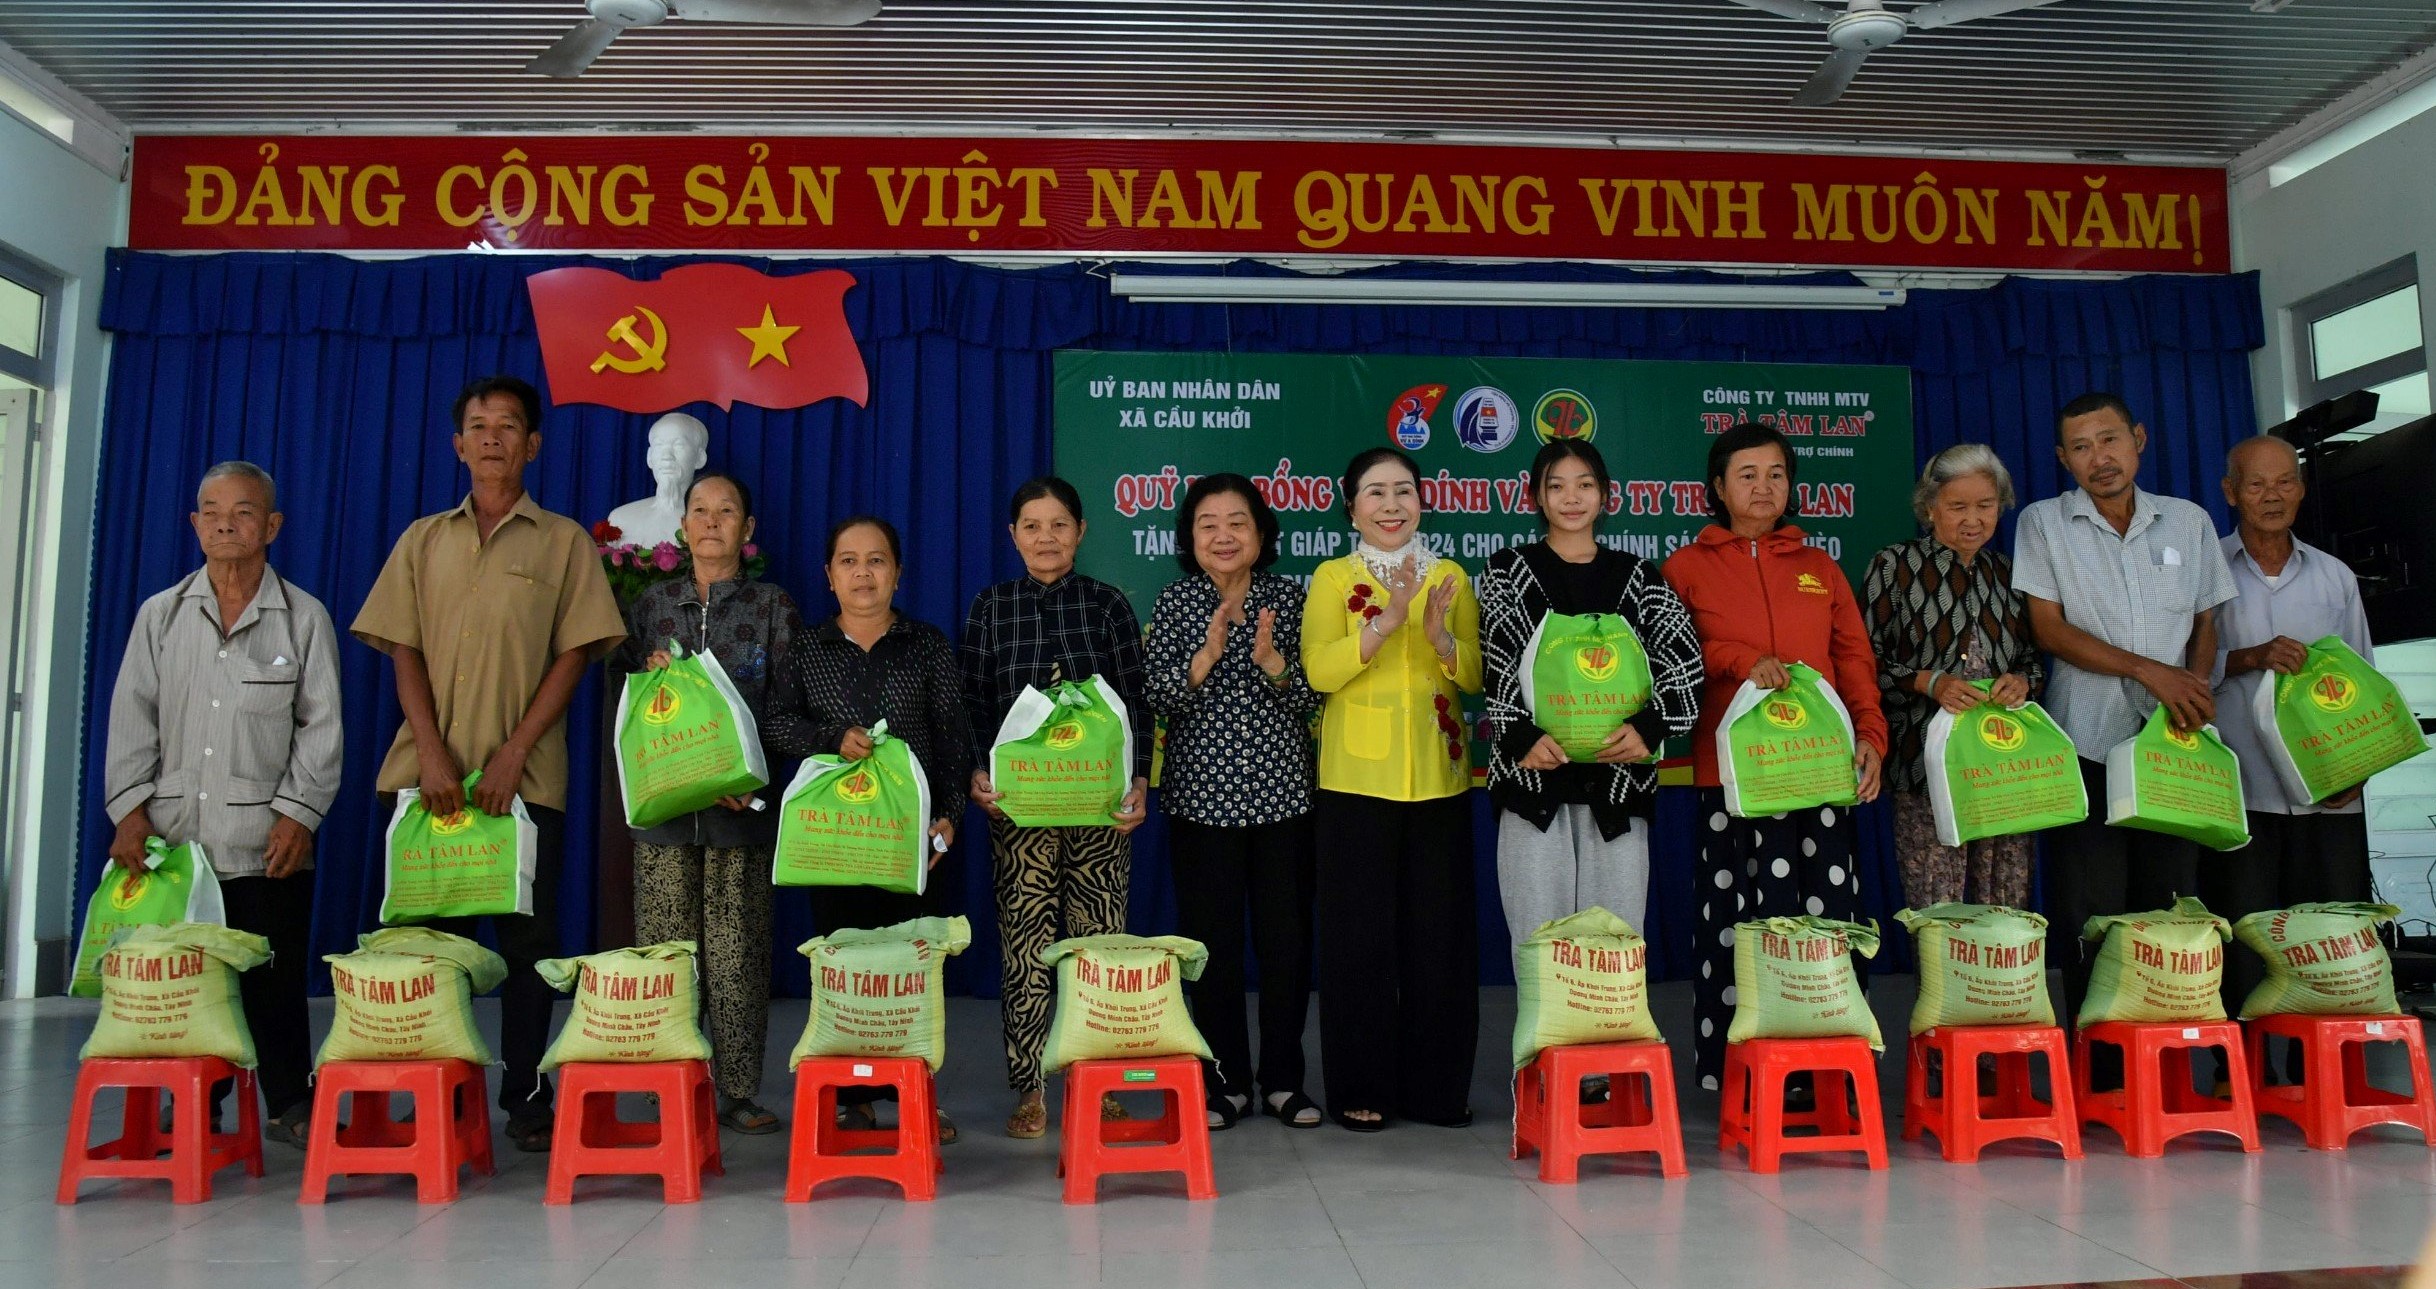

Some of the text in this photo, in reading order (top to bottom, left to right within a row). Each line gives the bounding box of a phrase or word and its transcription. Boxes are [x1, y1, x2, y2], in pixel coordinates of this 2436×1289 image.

[181, 142, 2204, 266] ĐẢNG CỘNG SẢN VIỆT NAM QUANG VINH MUÔN NĂM!
[1123, 381, 1166, 399] BAN
[1173, 379, 1230, 399] NHÂN
[1237, 380, 1280, 400] DÂN
[1703, 387, 1869, 407] CÔNG TY TNHH MTV
[1119, 405, 1251, 428] XÃ CẦU KHỞI
[1758, 409, 1813, 435] TÂM
[1817, 445, 1854, 457] CHÍNH
[1115, 465, 1180, 517] QUỸ
[1251, 458, 1334, 511] BỔNG
[1420, 469, 1491, 513] DÍNH
[1626, 480, 1666, 515] TY
[1669, 480, 1716, 515] TR
[1798, 483, 1854, 517] LAN
[1291, 527, 1341, 556] GIÁP
[1462, 533, 1504, 558] CHO
[1582, 691, 1617, 705] TÂM
[2334, 718, 2369, 737] TÂM
[1746, 739, 1777, 757] TRÀ
[1782, 735, 1816, 752] TÂM
[1010, 757, 1038, 772] TRÀ
[1044, 758, 1080, 772] TÂM
[1996, 759, 2032, 773] TÂM
[836, 810, 871, 827] TÂM
[1588, 947, 1621, 973] TÂM
[1761, 933, 1791, 960] TRÀ
[1796, 936, 1828, 962] TÂM
[1949, 938, 2041, 969] TRÀ TÂM LAN
[2133, 940, 2222, 975] TRÀ TÂM LAN
[2282, 927, 2379, 967] TRÀ TÂM LAN
[127, 953, 162, 981] TÂM
[169, 949, 205, 979] LAN
[1077, 956, 1170, 993] TRÀ TÂM LAN
[334, 967, 435, 1004] TRÀ TÂM LAN
[582, 964, 674, 1001] TRÀ TÂM LAN
[821, 965, 925, 998] TRÀ TÂM LAN
